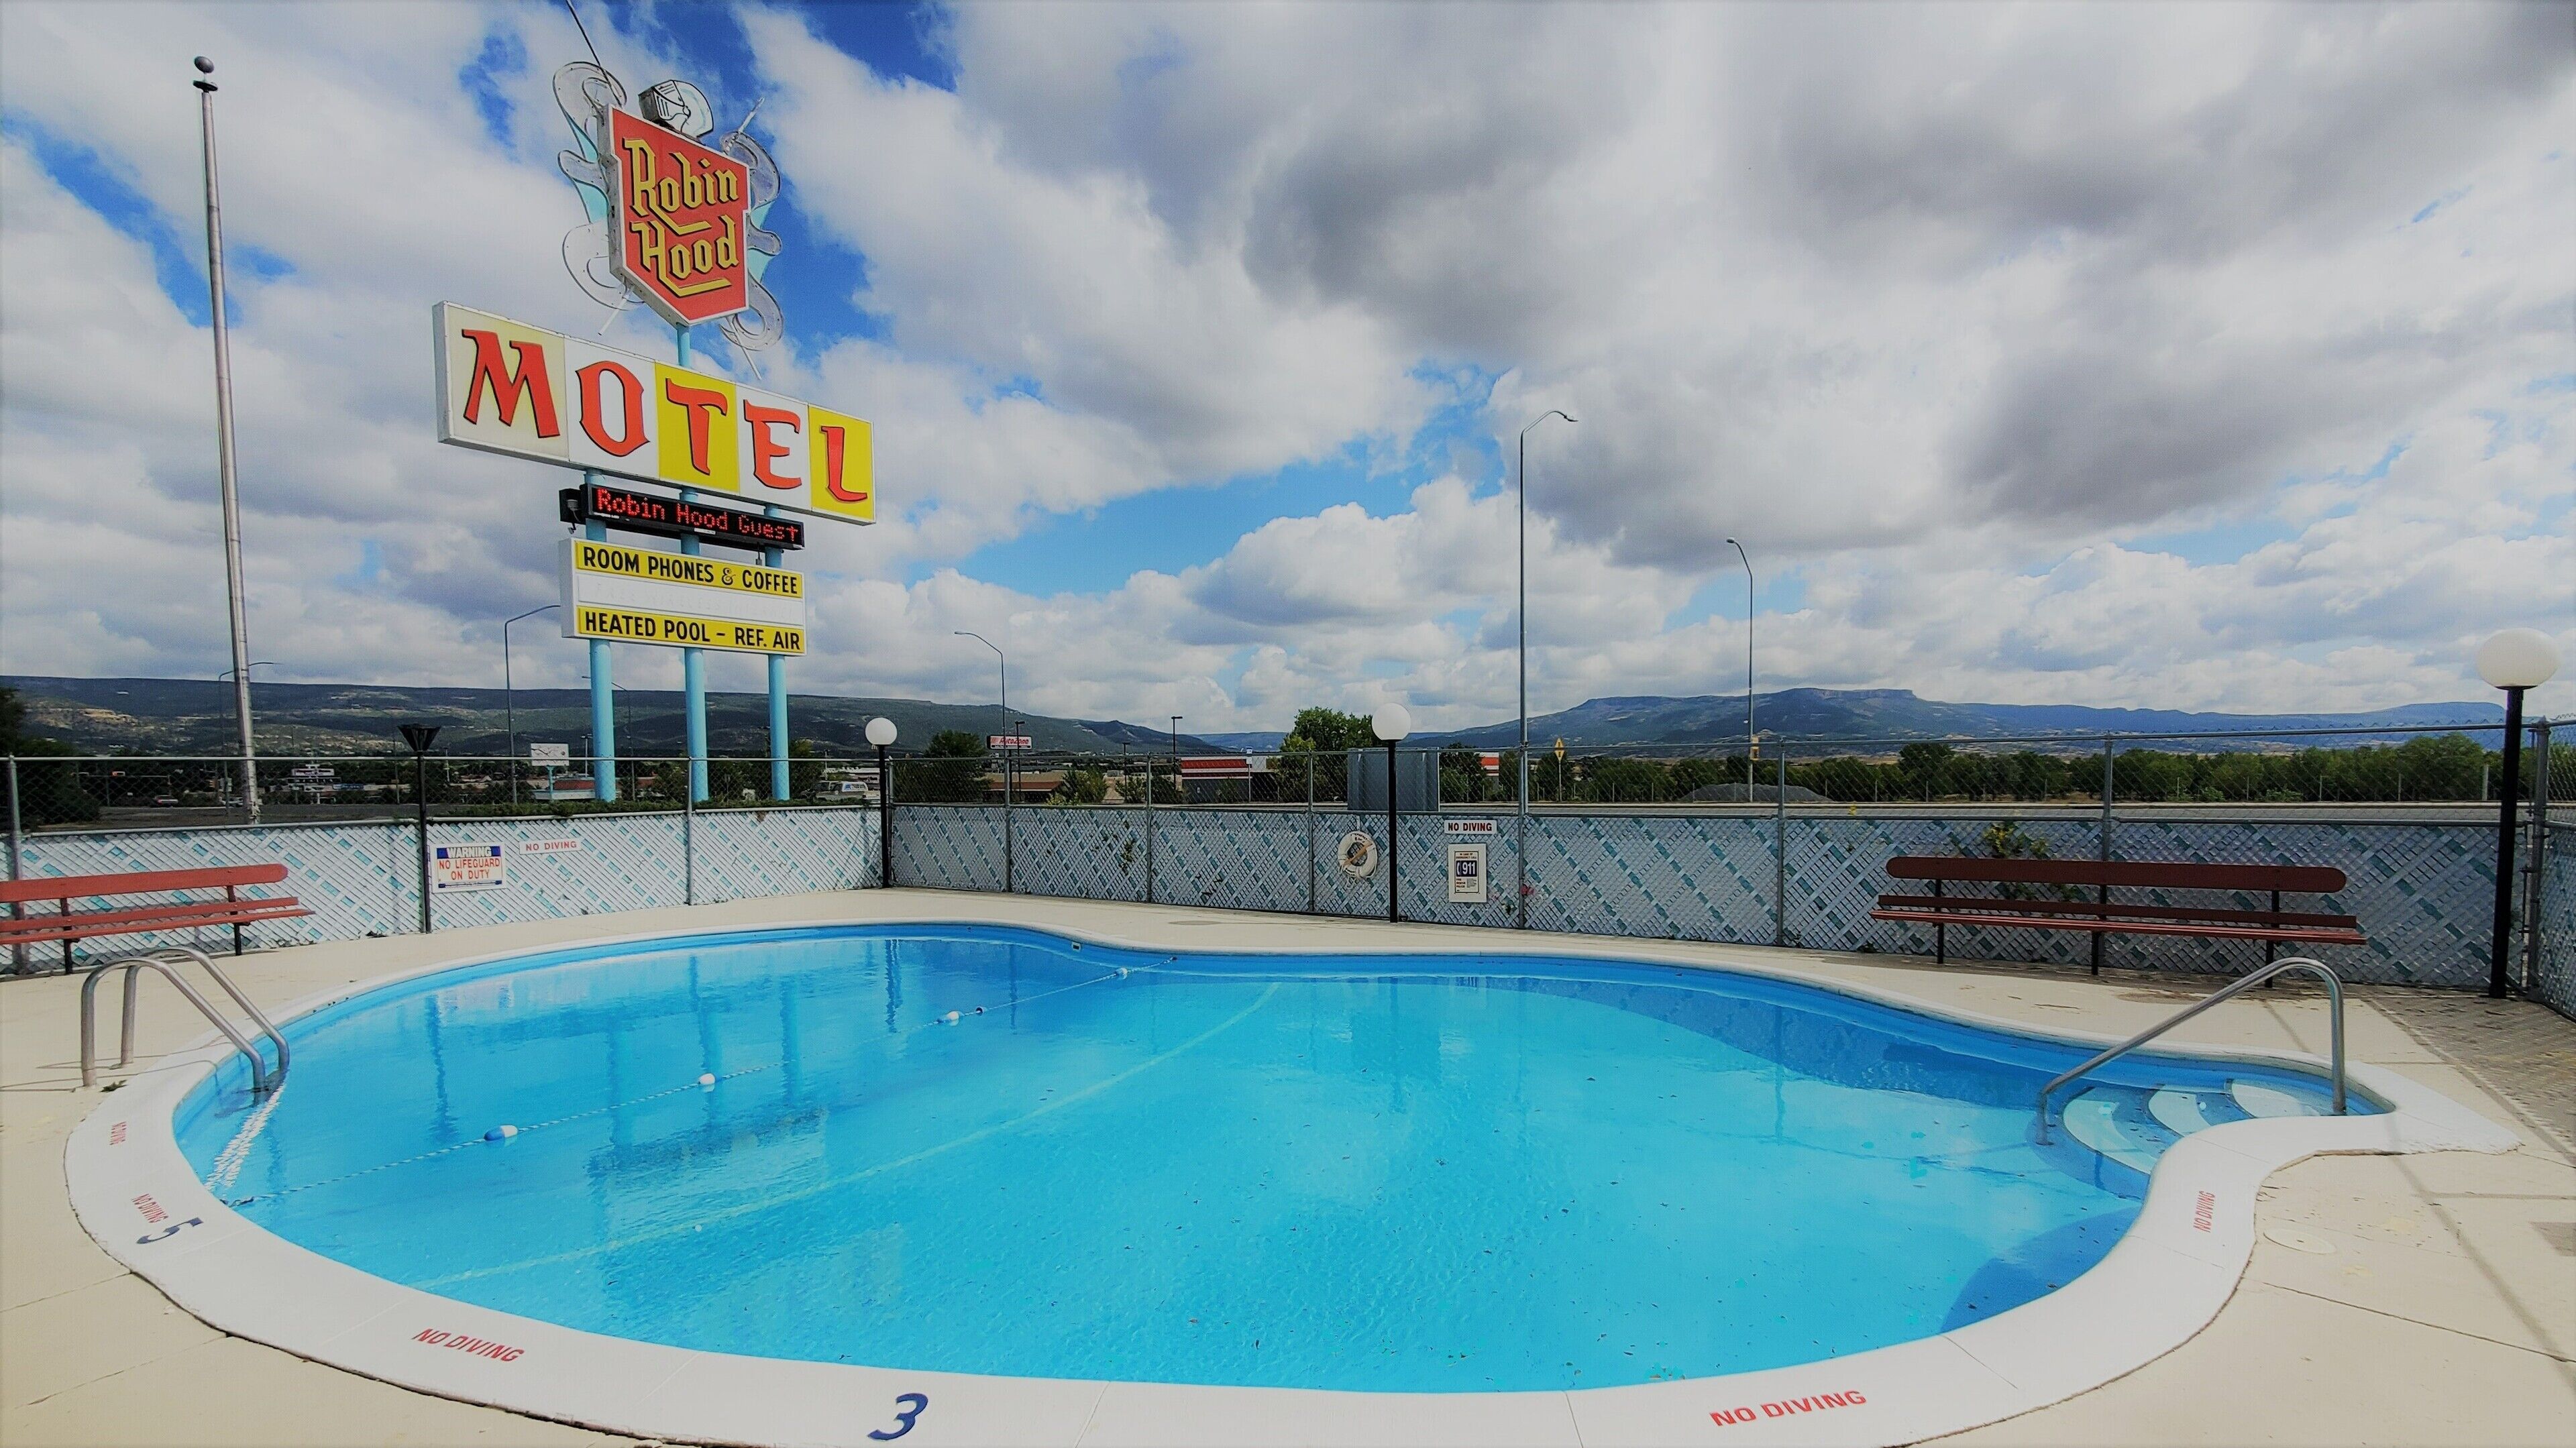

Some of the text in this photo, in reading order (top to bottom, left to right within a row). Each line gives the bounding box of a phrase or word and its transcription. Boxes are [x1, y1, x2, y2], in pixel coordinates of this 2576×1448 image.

[623, 136, 739, 235] Robin
[629, 213, 740, 298] Hood
[462, 329, 868, 502] MOTEL
[596, 488, 799, 541] Robin Hood Guest
[583, 546, 798, 595] ROOM PHONES & COFFEE
[585, 611, 657, 637] HEATED
[664, 619, 711, 642] POOL
[734, 626, 767, 647] REF.
[772, 630, 801, 650] AIR
[1448, 822, 1493, 832] NO DIVING
[446, 846, 492, 858] WARNING
[526, 841, 577, 851] NO DIVING
[439, 858, 500, 870] NO LIFEGUARD
[451, 869, 490, 881] ON DUTY
[1462, 862, 1475, 875] 911
[136, 1217, 204, 1244] 5
[411, 1328, 525, 1361] NO DIVING
[867, 1392, 928, 1441] 3
[1709, 1390, 1867, 1427] NO DIVING
